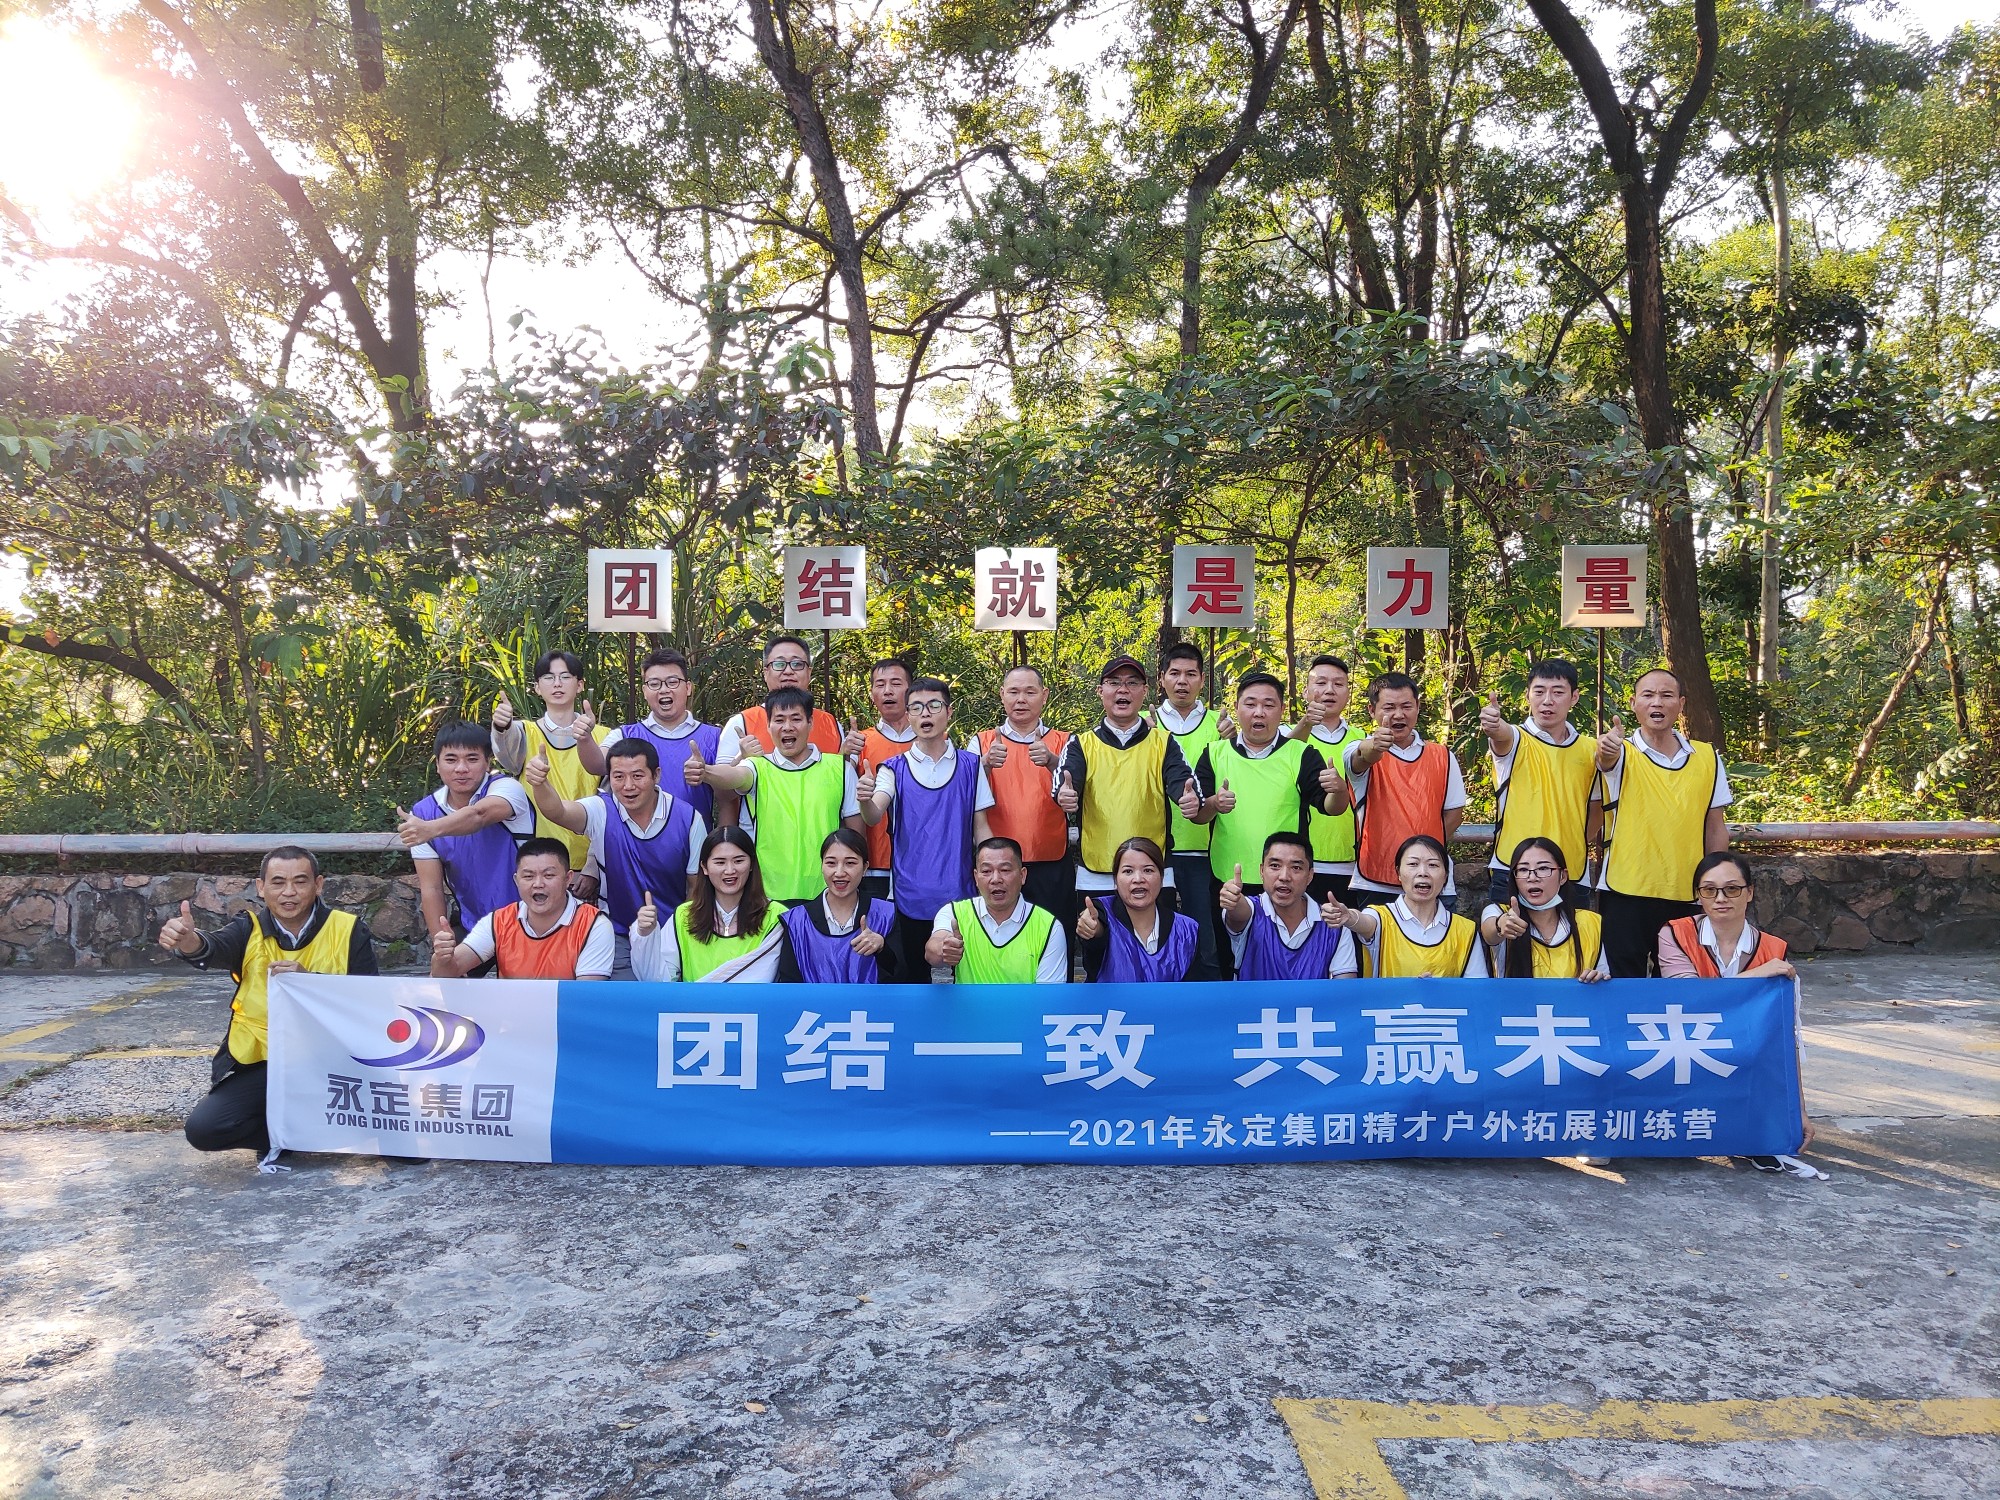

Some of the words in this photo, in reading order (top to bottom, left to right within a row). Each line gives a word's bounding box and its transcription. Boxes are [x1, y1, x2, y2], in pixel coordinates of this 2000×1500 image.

[604, 563, 657, 619] 团
[797, 558, 855, 617] 结
[987, 560, 1046, 618] 就
[1187, 557, 1244, 615] 是
[1384, 560, 1434, 616] 力
[1577, 557, 1637, 615] 量
[655, 1009, 1156, 1091] 团结一致
[1232, 1003, 1738, 1088] 共赢未来
[325, 1112, 368, 1128] YONG
[371, 1117, 410, 1132] DING
[414, 1120, 514, 1137] INDUSTRIAL
[327, 1073, 515, 1122] 永定集团
